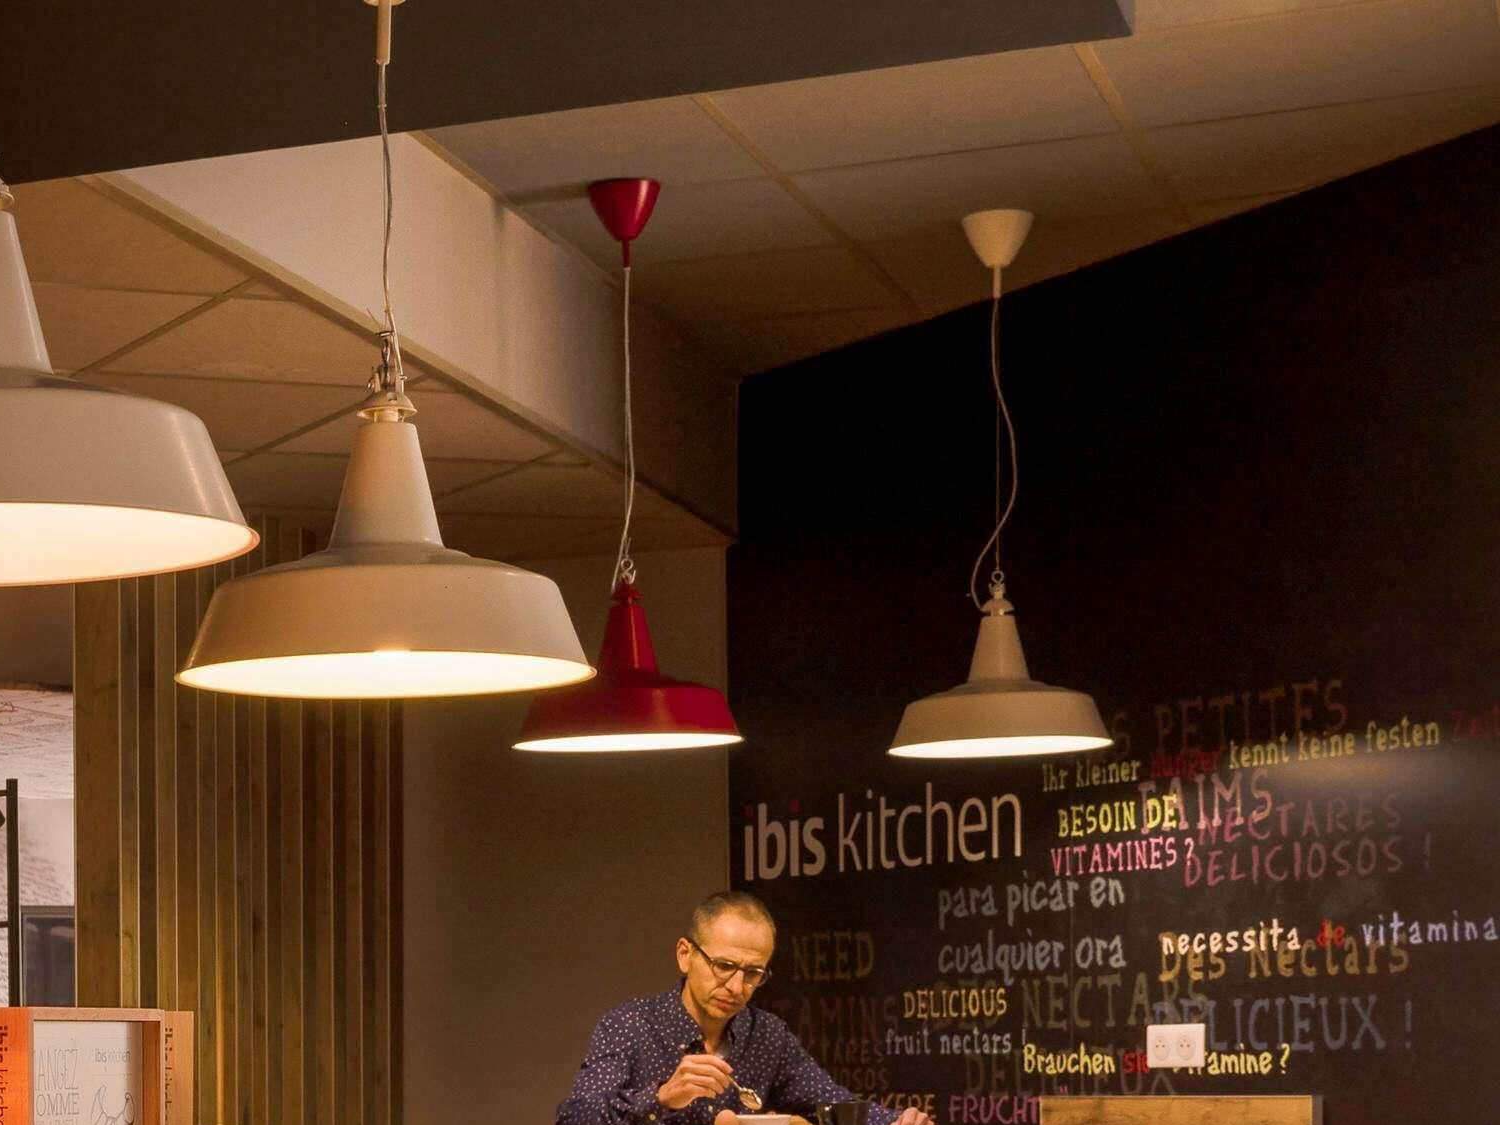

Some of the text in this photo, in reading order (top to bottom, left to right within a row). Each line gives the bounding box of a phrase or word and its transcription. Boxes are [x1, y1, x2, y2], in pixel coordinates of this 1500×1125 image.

[1042, 763, 1068, 792] Ihr
[1075, 760, 1141, 788] kleiner
[1229, 740, 1290, 769] kennt
[1298, 730, 1355, 762] keine
[1364, 714, 1440, 753] festen
[744, 782, 1022, 881] ibis kitchen
[1057, 793, 1178, 838] BESOIN DE
[1050, 837, 1177, 877] VITAMINES
[1183, 833, 1403, 888] DELICIOSOS
[938, 870, 1127, 931] para picar en
[790, 930, 876, 982] NEED
[937, 928, 1128, 987] cualquier ora
[1161, 917, 1301, 955] necessita
[1316, 917, 1346, 951] de
[902, 986, 1008, 1020] DELICIOUS
[885, 1026, 932, 1056] fruit
[939, 1026, 1012, 1056] nectars
[1022, 1041, 1116, 1077] Brauchen
